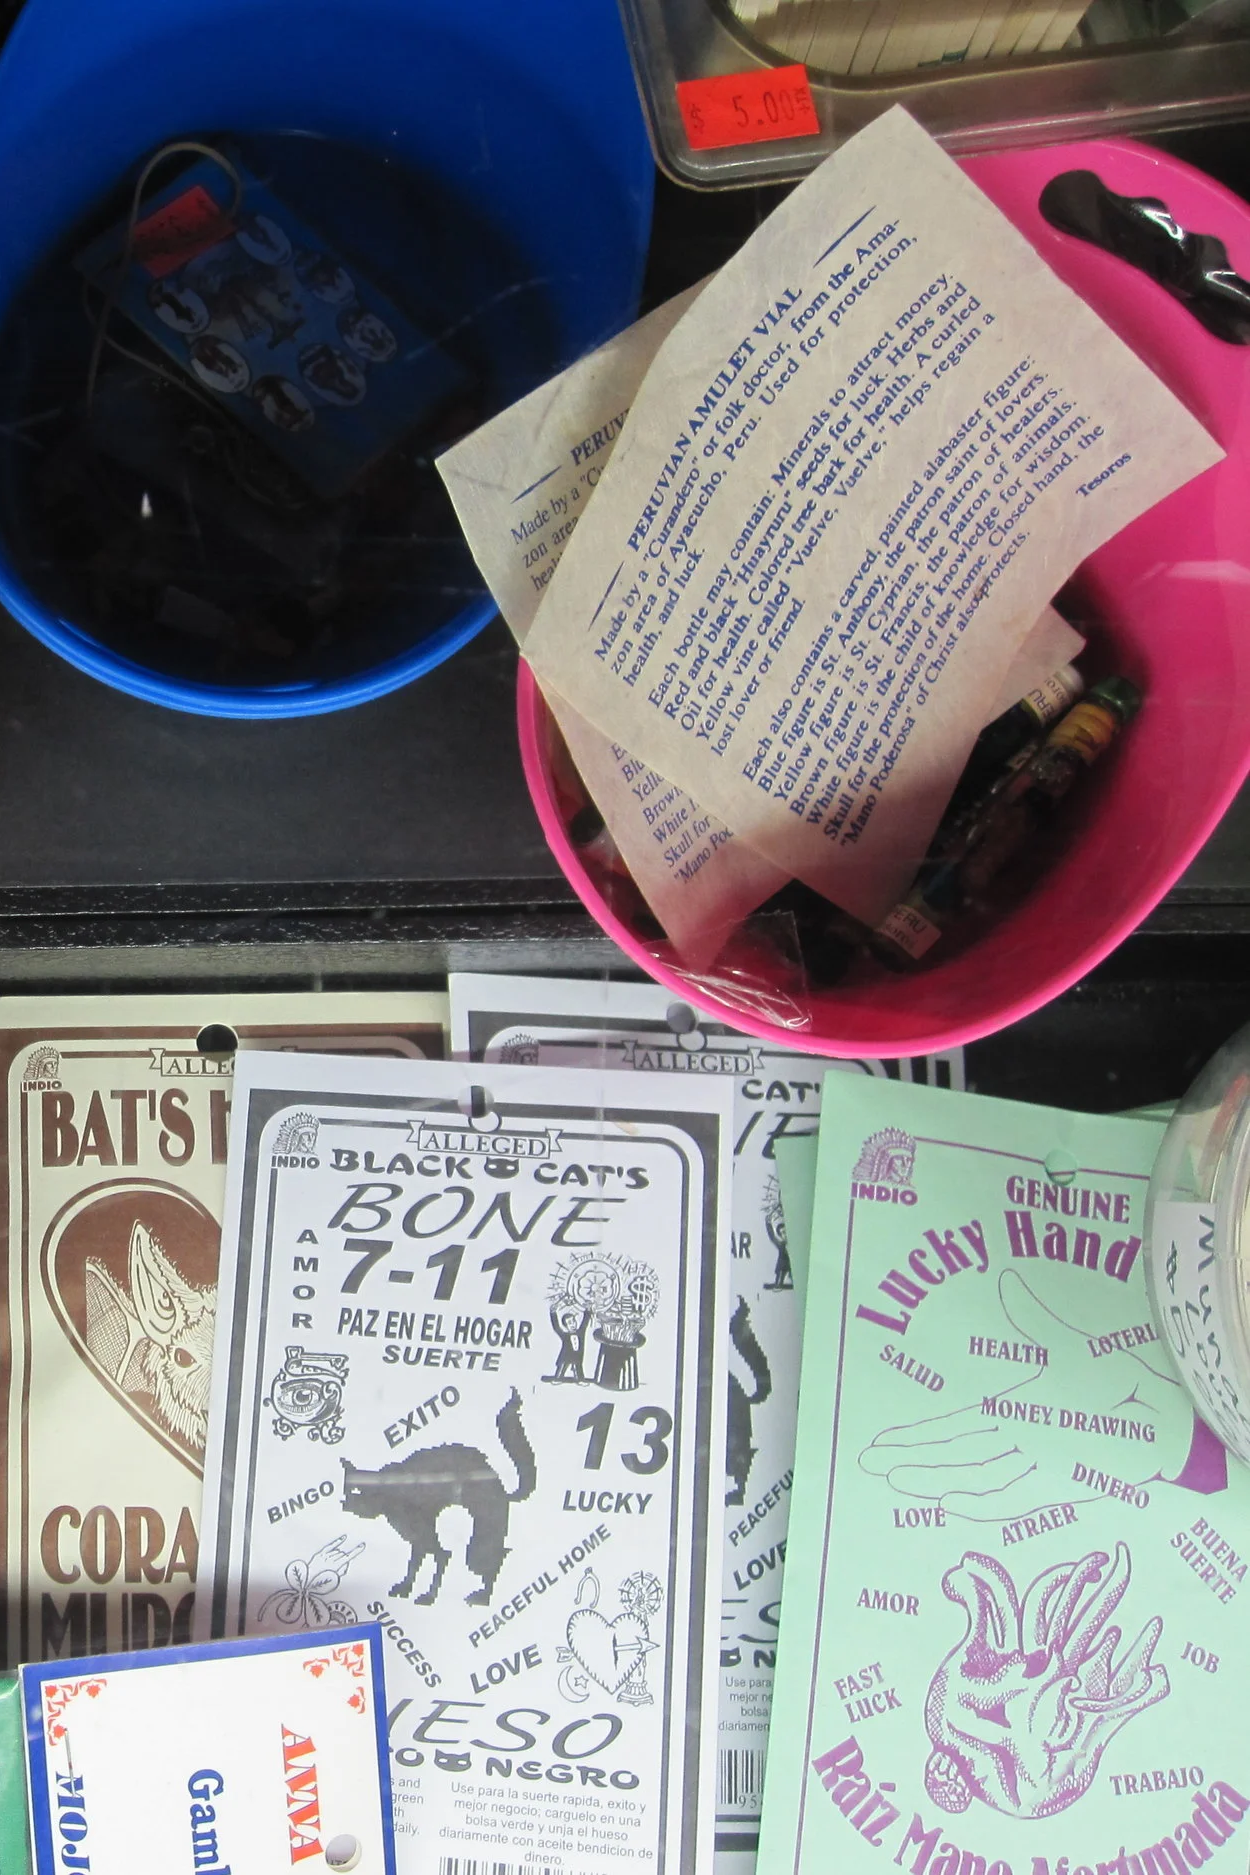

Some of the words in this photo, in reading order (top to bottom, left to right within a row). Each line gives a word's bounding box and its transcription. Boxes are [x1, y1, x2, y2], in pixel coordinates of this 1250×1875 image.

[690, 103, 706, 134] $
[856, 219, 899, 264] Ama-
[827, 262, 855, 290] the
[790, 290, 830, 334] from
[742, 340, 791, 398] doctor,
[627, 431, 691, 552] PERUVIAN
[688, 336, 756, 436] AMULET
[752, 287, 802, 335] VIAL
[715, 398, 746, 436] folk
[610, 639, 633, 674] zon
[632, 593, 658, 633] area
[656, 560, 670, 587] of
[669, 469, 727, 563] Ayacucho,
[722, 415, 762, 461] Peru.
[758, 356, 800, 405] Used
[799, 325, 825, 356] for
[827, 236, 917, 327] protection,
[703, 435, 719, 457] or
[1075, 452, 1132, 497] Tesoros
[643, 455, 700, 562] "Curandero"
[622, 583, 641, 608] by
[638, 569, 649, 582] a
[594, 609, 627, 661] Made
[622, 630, 662, 687] health,
[658, 587, 680, 625] and
[673, 548, 705, 589] luck.
[167, 1058, 235, 1075] ALLE
[639, 1052, 750, 1074] ALLEGED
[23, 1080, 62, 1091] INDIO
[42, 1088, 195, 1167] BAT'S
[423, 1133, 546, 1157] ALLEGED
[271, 1156, 320, 1169] INDIO
[330, 1149, 471, 1179] BLACK
[534, 1163, 649, 1189] CAT'S
[851, 1182, 918, 1206] INDIO
[1006, 1175, 1131, 1224] GENUINE
[327, 1183, 628, 1247] BONE
[340, 1238, 521, 1305] 7-11
[855, 1220, 990, 1335] Lucky
[1004, 1211, 1142, 1283] Hand
[337, 1307, 378, 1338] PAZ
[385, 1310, 415, 1340] EN
[420, 1314, 447, 1342] EL
[454, 1317, 532, 1349] HOGAR
[382, 1345, 501, 1372] SUERTE
[879, 1344, 945, 1392] SALUD
[969, 1335, 1050, 1366] HEALTH
[384, 1386, 461, 1448] EXITO
[981, 1396, 1052, 1426] MONEY
[1058, 1409, 1156, 1443] DRAWING
[576, 1402, 673, 1475] 13
[267, 1480, 334, 1524] BINGO
[563, 1490, 653, 1515] LUCKY
[1071, 1462, 1149, 1509] DINERO
[893, 1508, 946, 1529] LOVE
[1001, 1503, 1078, 1547] ATRAER
[1170, 1531, 1237, 1605] SUERTE
[1189, 1517, 1249, 1583] BUENA
[469, 1570, 559, 1648] PEACEFUL
[558, 1524, 612, 1574] HOME
[856, 1588, 920, 1615] AMOR
[367, 1600, 442, 1688] SUCCESS
[1180, 1641, 1221, 1674] JOB
[470, 1644, 542, 1694] LOVE
[833, 1662, 885, 1700] FAST
[845, 1688, 902, 1723] LUCK
[281, 1723, 324, 1865] ANNA
[486, 1757, 640, 1790] NEGRO
[1109, 1766, 1204, 1797] TRABAJO
[451, 1781, 474, 1795] Use
[478, 1786, 504, 1800] para
[508, 1787, 519, 1799] la
[522, 1790, 560, 1804] suerte
[563, 1793, 604, 1809] rapida,
[607, 1800, 636, 1812] exito
[640, 1802, 647, 1814] y
[454, 1799, 487, 1813] mejor
[491, 1802, 541, 1818] negocio;
[545, 1808, 597, 1824] carguelo
[600, 1814, 615, 1824] en
[618, 1815, 641, 1827] una
[439, 1828, 509, 1845] diariamente
[512, 1835, 533, 1847] con
[537, 1837, 573, 1851] aceite
[577, 1840, 635, 1857] bendicion
[638, 1846, 653, 1859] de
[465, 1814, 497, 1828] bolsa
[501, 1818, 534, 1832] verde
[538, 1823, 545, 1835] y
[548, 1823, 574, 1837] unja
[578, 1825, 588, 1837] el
[592, 1827, 628, 1841] hueso
[524, 1852, 565, 1866] dinero.
